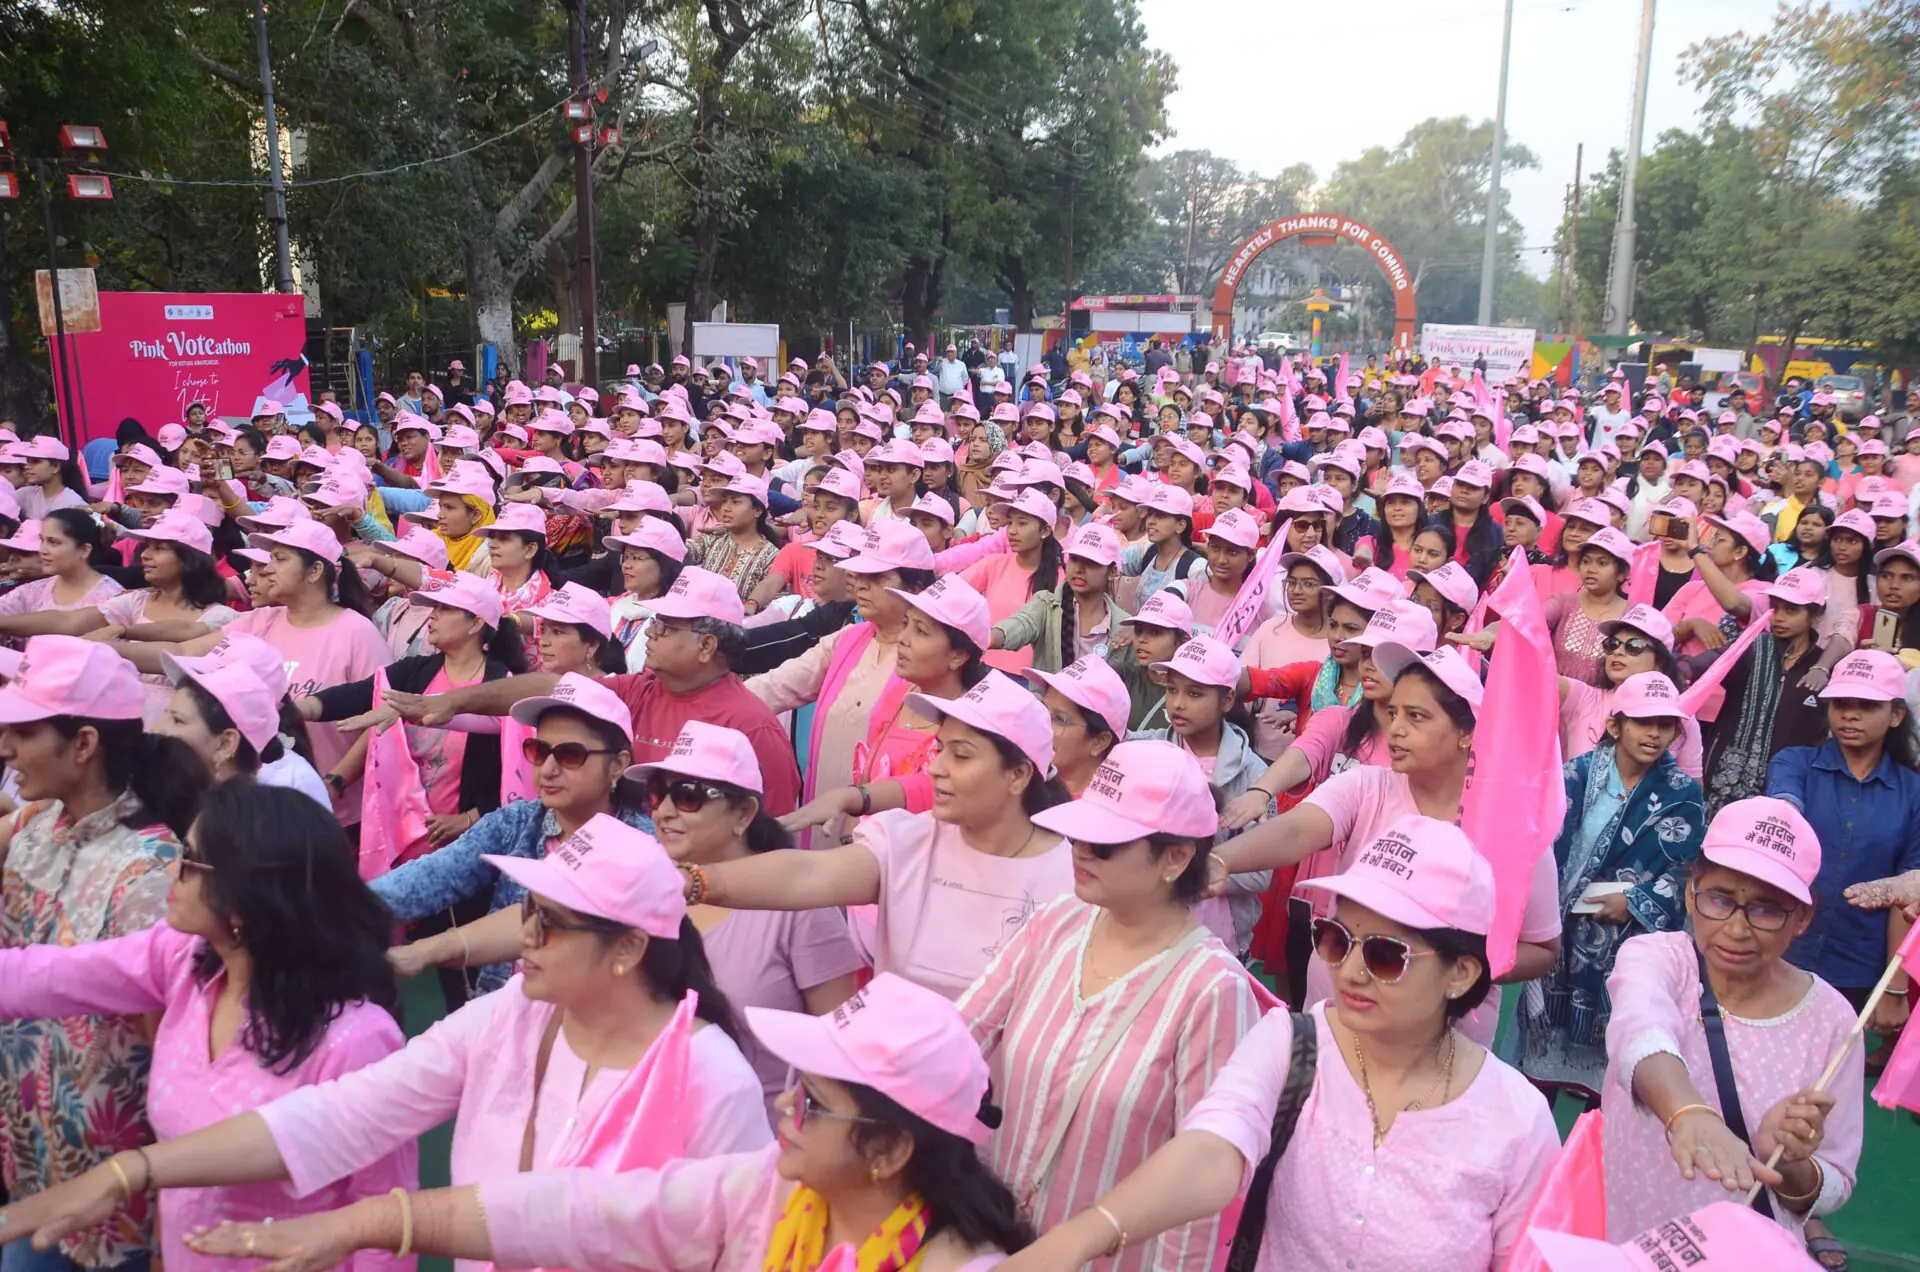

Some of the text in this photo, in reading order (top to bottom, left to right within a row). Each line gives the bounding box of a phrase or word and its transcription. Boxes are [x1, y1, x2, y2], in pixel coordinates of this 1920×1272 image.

[1224, 217, 1408, 290] HEARTILY THANKS FOR COMING
[130, 331, 250, 360] Pink Voteathon
[173, 370, 219, 390] I choose to
[1755, 820, 1796, 846] मतदान
[1372, 838, 1418, 863] मतदान
[1757, 835, 1771, 848] भी
[1771, 840, 1792, 858] नंबर
[1792, 852, 1796, 861] 1
[1369, 853, 1383, 867] भी
[1381, 856, 1407, 876] नंबर
[1406, 870, 1414, 880] 1
